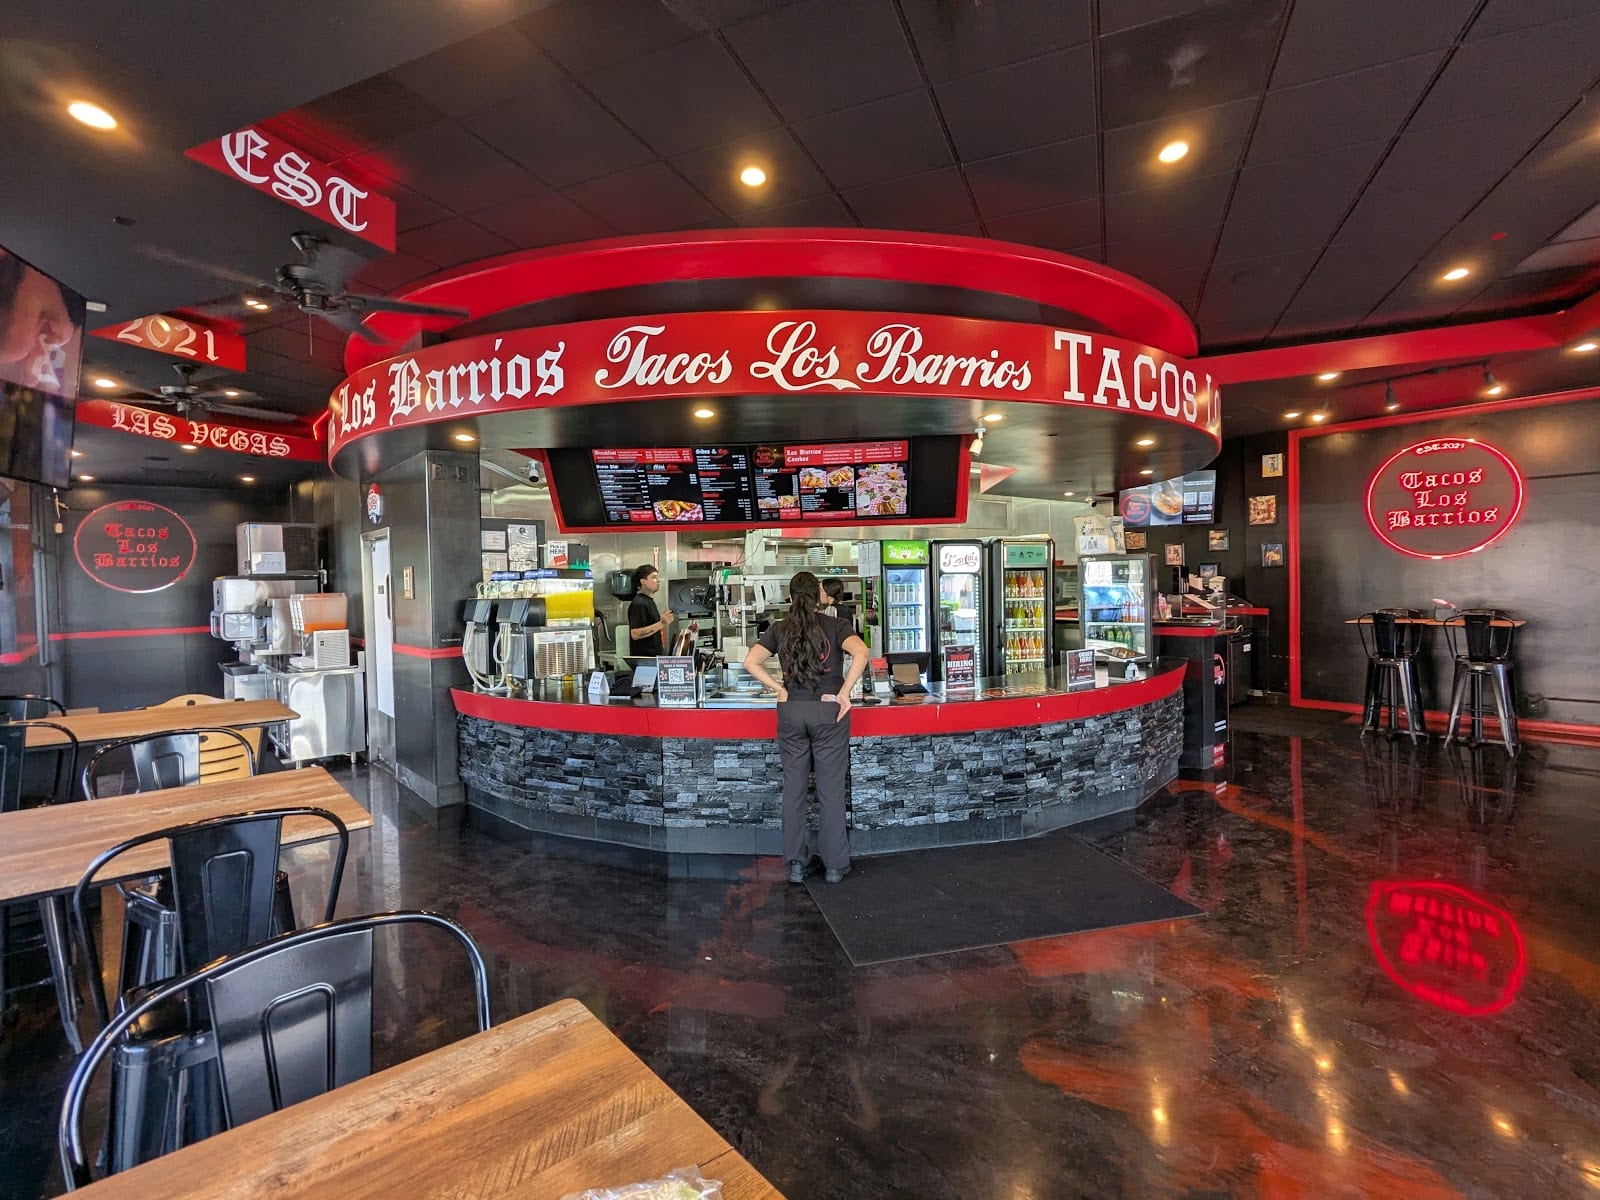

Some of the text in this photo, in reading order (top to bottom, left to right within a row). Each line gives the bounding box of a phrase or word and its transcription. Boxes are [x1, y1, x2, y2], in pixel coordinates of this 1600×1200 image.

[221, 129, 368, 232] EST
[117, 314, 219, 361] 2021
[595, 321, 1032, 391] Tacos Los Barrios
[1054, 330, 1198, 423] TACOS
[339, 379, 376, 438] Los
[388, 339, 566, 426] Barrios
[110, 404, 176, 439] LAS
[189, 421, 290, 456] VEGAS
[1401, 468, 1483, 489] Tacos
[1414, 490, 1468, 509] Los
[1388, 508, 1498, 530] Barrios
[104, 523, 169, 539] Tacos
[116, 539, 158, 554] Los
[93, 554, 180, 569] Barrios
[947, 660, 973, 668] HIRING
